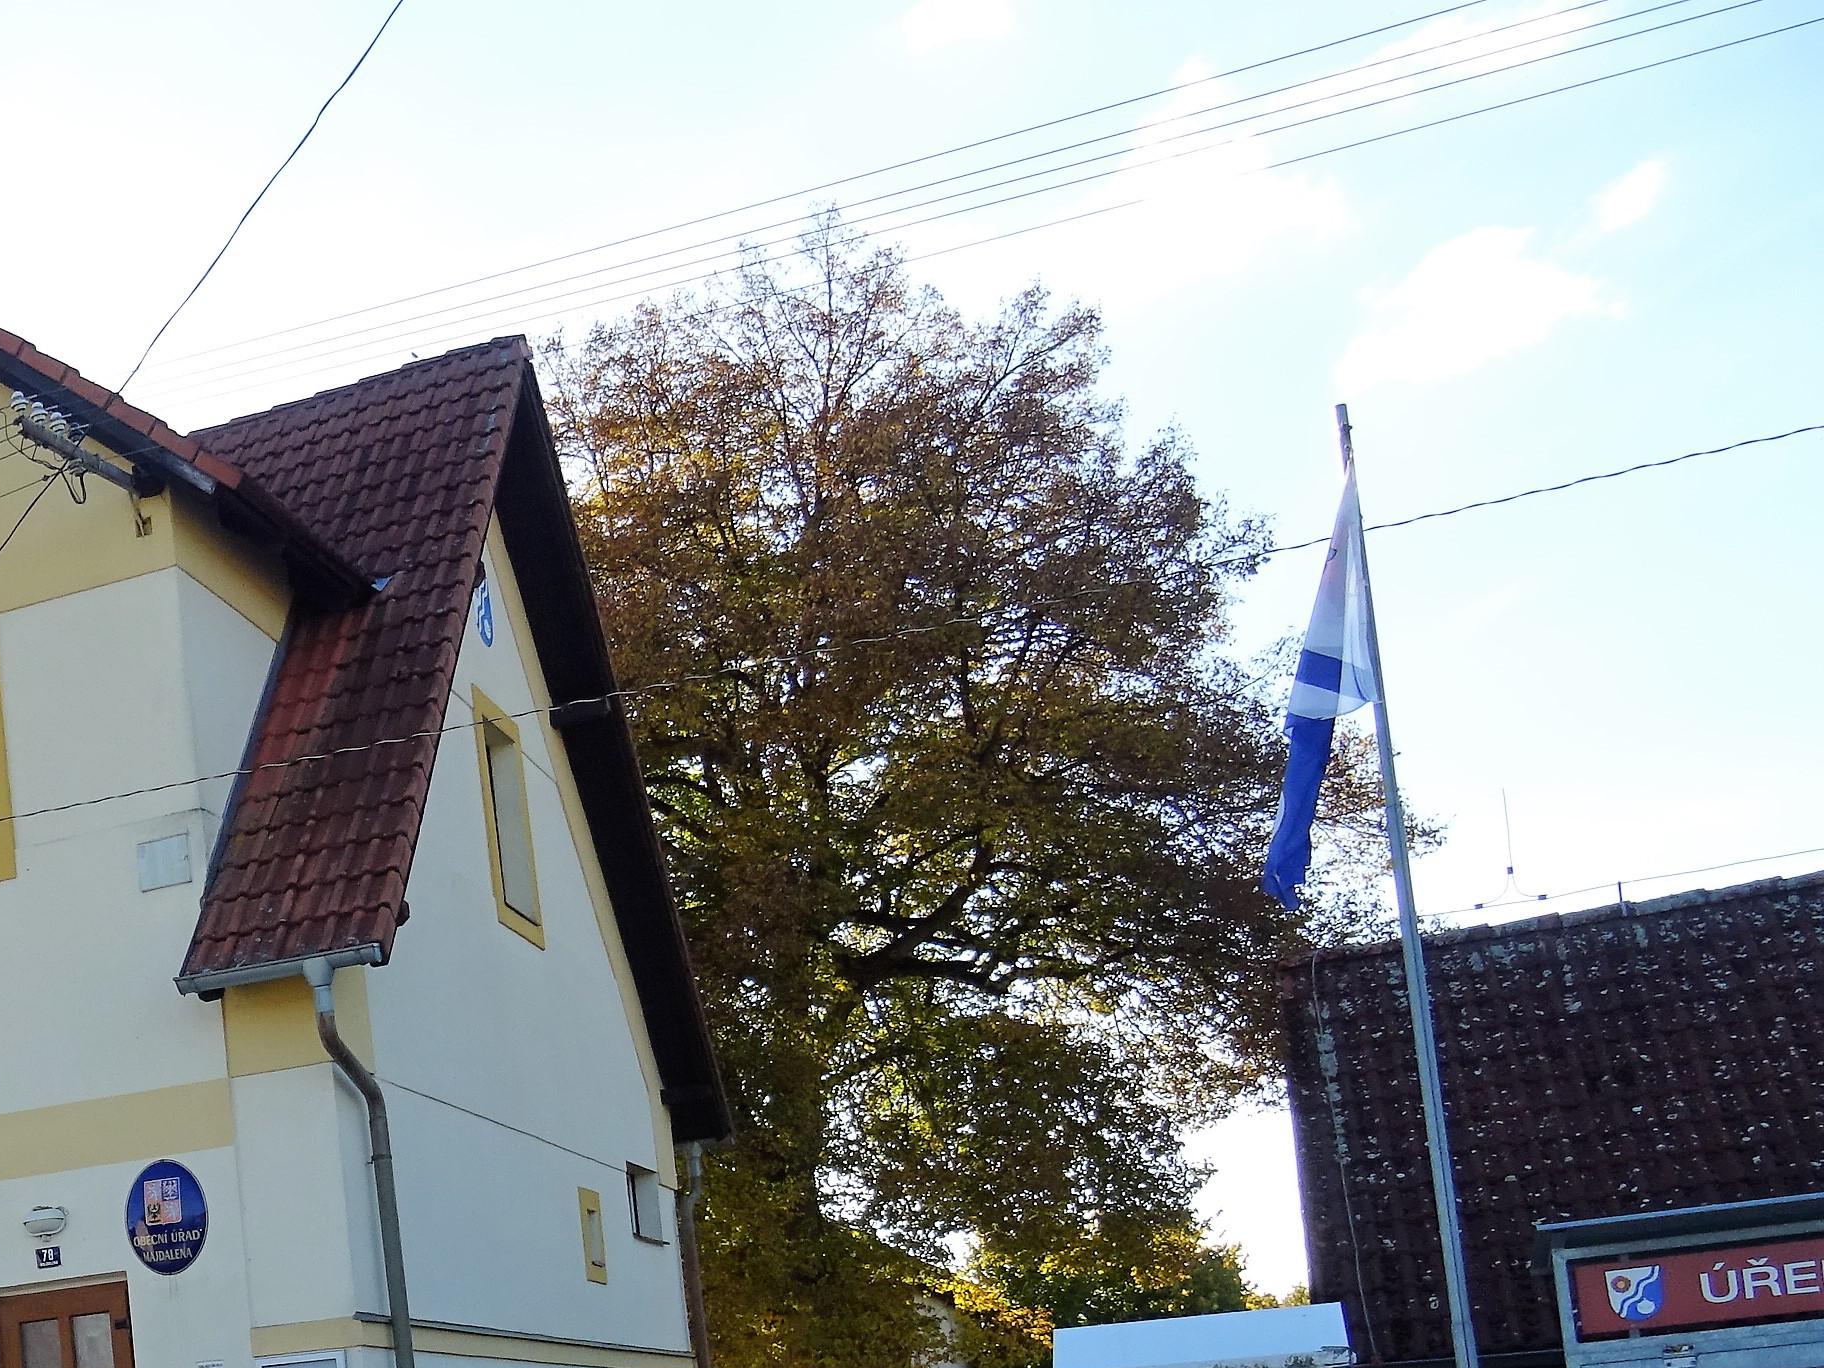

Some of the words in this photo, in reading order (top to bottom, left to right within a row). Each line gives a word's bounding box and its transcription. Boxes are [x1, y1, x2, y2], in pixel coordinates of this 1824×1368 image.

[133, 1229, 168, 1247] OBECNÍ
[171, 1228, 201, 1243] ÚŘAD
[42, 1249, 54, 1262] 78
[143, 1247, 193, 1262] MAJDALENA
[1699, 1257, 1824, 1304] ÚŘE
